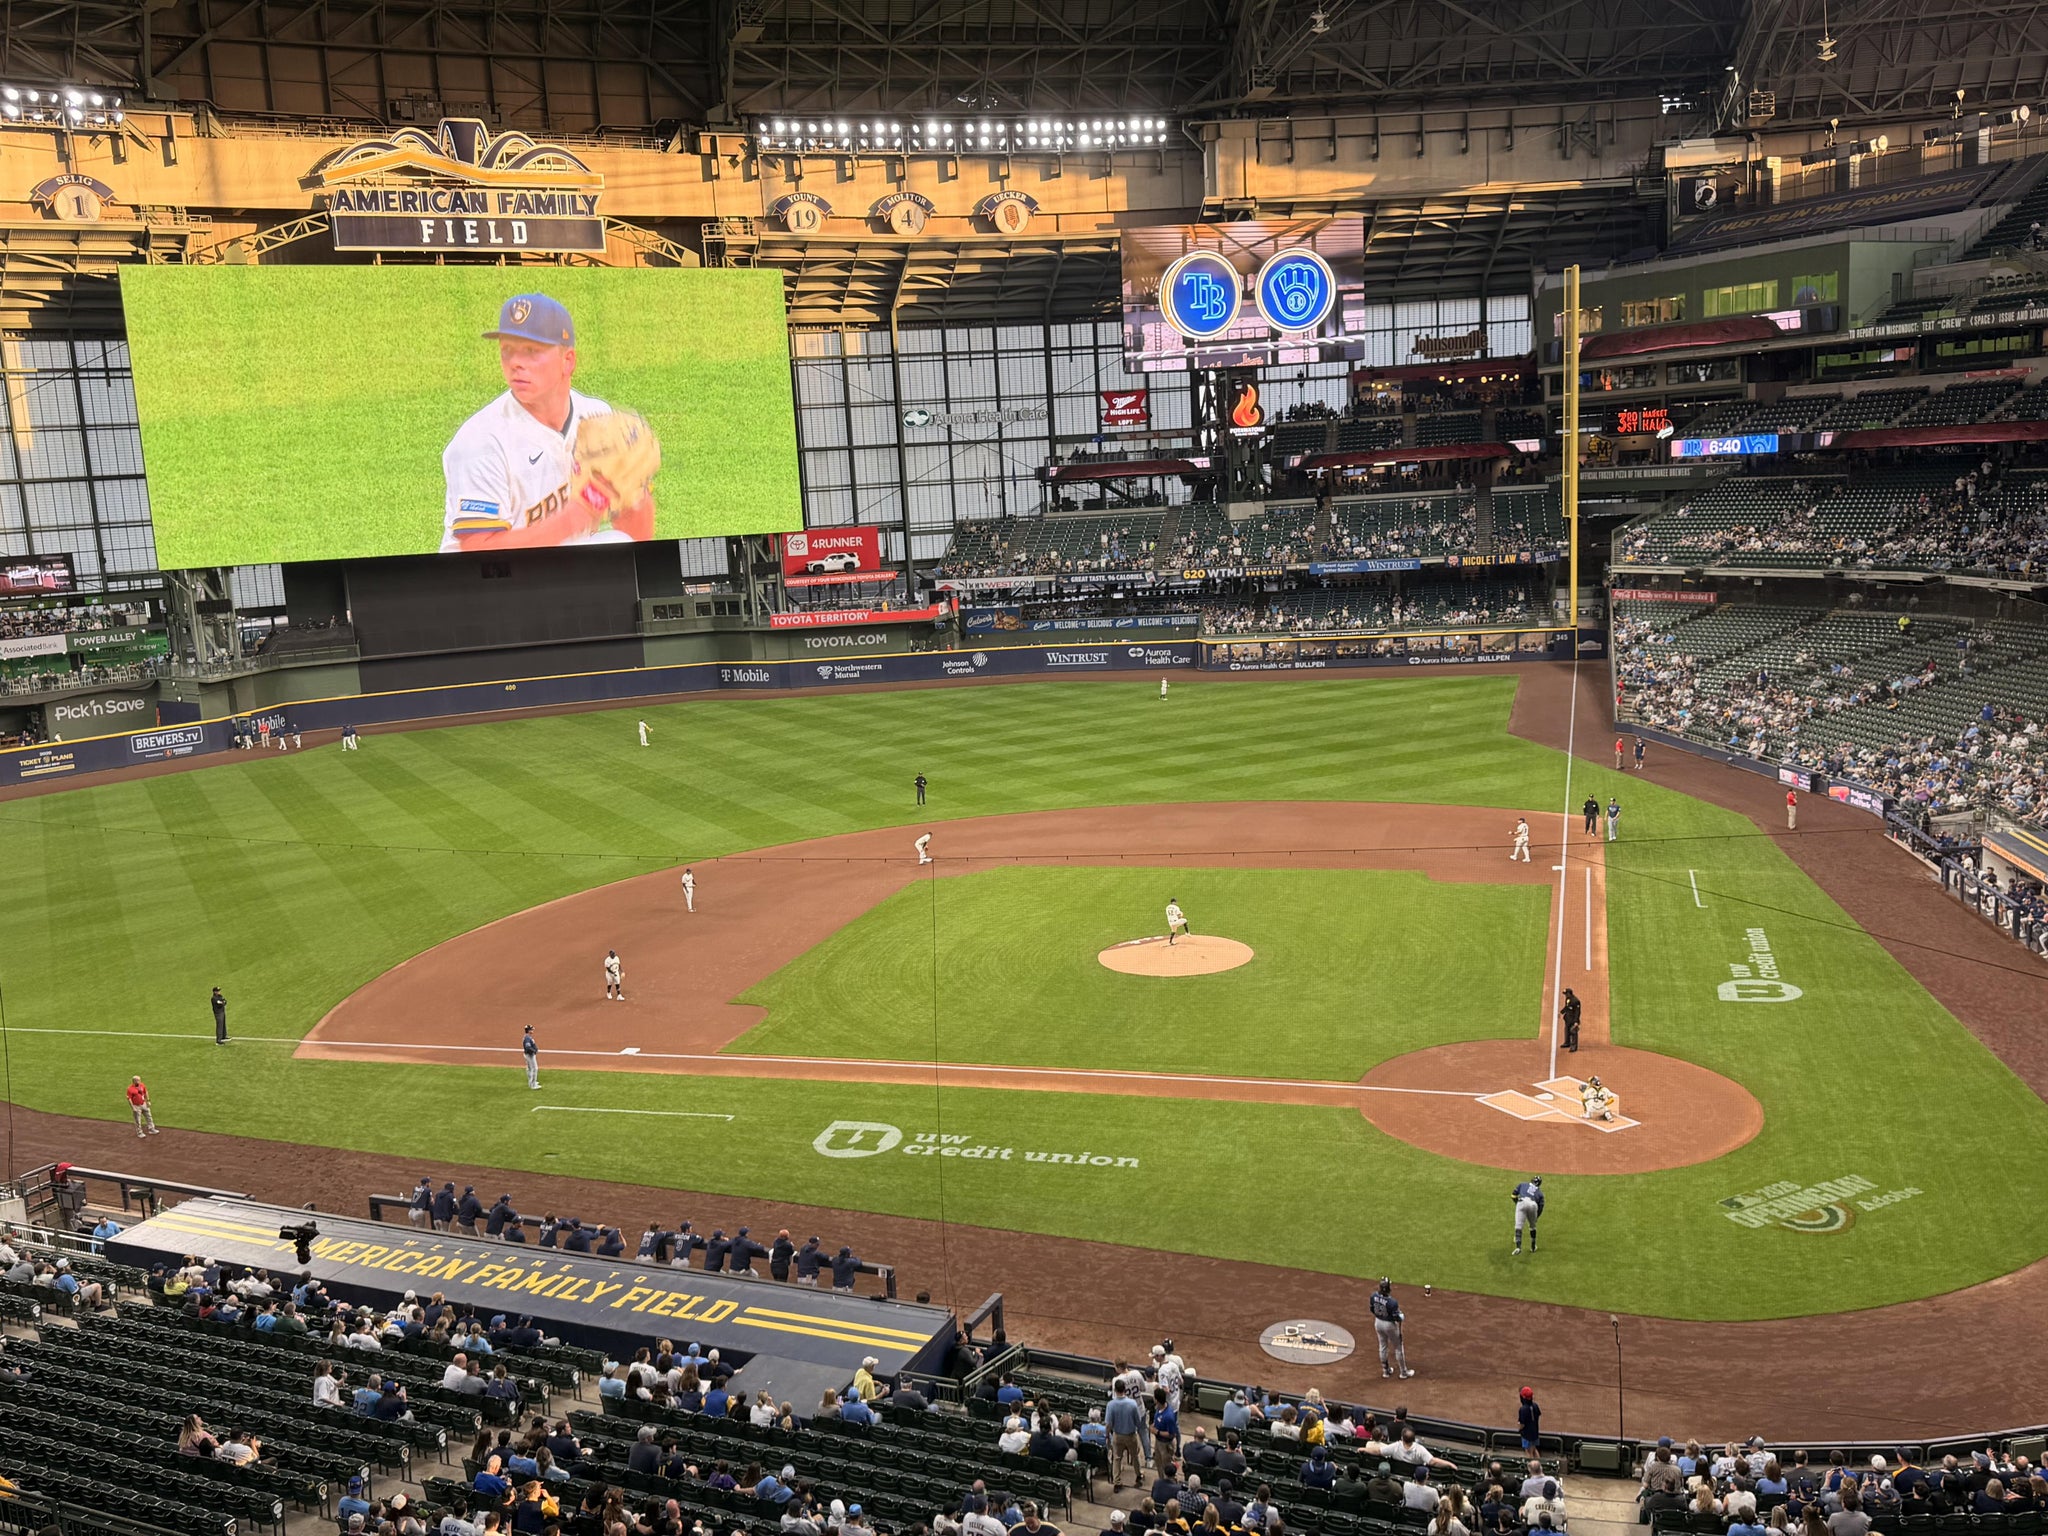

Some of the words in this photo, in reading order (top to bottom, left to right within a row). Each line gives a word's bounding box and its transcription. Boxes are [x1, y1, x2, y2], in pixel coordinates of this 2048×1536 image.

[56, 175, 93, 186] SELIG
[333, 189, 489, 214] AMERICAN
[501, 192, 600, 217] FAMILY
[787, 193, 819, 204] YOUNT
[886, 193, 928, 206] MOLITOR
[993, 191, 1027, 203] UECKER
[72, 195, 89, 218] 1
[1719, 217, 1765, 233] MUST
[1765, 212, 1787, 224] BE
[1790, 208, 1809, 219] IN
[1815, 202, 1849, 214] THE
[1850, 190, 1914, 208] FRONT
[1916, 180, 1973, 197] ROW!
[792, 210, 817, 230] 19
[900, 208, 912, 228] 4
[421, 219, 528, 245] FIELD
[1183, 273, 1227, 320] TB
[1849, 329, 1855, 339] TO
[1857, 327, 1874, 338] REPORT
[1876, 326, 1885, 337] FAN
[1886, 323, 1919, 335] MISCONDUCT:
[1922, 320, 1935, 331] TEXT
[1999, 312, 2016, 322] ISSUE
[2017, 310, 2028, 321] AND
[1411, 329, 1488, 354] Johnsonville
[935, 412, 975, 425] Aurora
[977, 407, 1018, 422] Health
[1019, 407, 1048, 421] Care
[1110, 408, 1126, 416] HIGH
[1127, 407, 1140, 415] LIFE
[1642, 408, 1667, 418] MARKET
[1642, 418, 1666, 431] HALL
[1709, 439, 1741, 454] 6:40
[1580, 471, 1598, 480] OFFICIAL
[1599, 470, 1614, 480] FROZEN
[1615, 469, 1627, 479] PIZZA
[1628, 469, 1634, 478] OF
[1634, 469, 1642, 478] THE
[1643, 468, 1669, 478] MILWAUKEE
[812, 536, 863, 549] 4RUNNER
[1367, 559, 1415, 570] WINTRUST
[1462, 556, 1496, 567] NICOLET
[1499, 554, 1516, 565] LAW
[786, 578, 808, 586] COURTESY
[830, 575, 857, 583] WISCONSIN
[857, 573, 874, 581] TOYOTA
[875, 572, 895, 580] DEALERS
[1116, 573, 1144, 581] CALORIES.
[1183, 569, 1205, 580] 620
[1207, 568, 1243, 578] WTMJ
[1246, 569, 1282, 577] BREWERS
[1637, 591, 1653, 599] family
[773, 614, 812, 625] TOYOTA
[814, 611, 869, 623] TERRITORY
[1054, 620, 1079, 630] WELCOME
[1088, 619, 1112, 628] DELICIOUS
[1138, 617, 1164, 627] WELCOME
[1171, 616, 1198, 626] DELICIOUS
[74, 635, 106, 647] POWER
[108, 632, 136, 643] ALLEY
[804, 633, 887, 649] TOYOTA.COM
[139, 643, 156, 651] CREW
[1146, 649, 1171, 657] Aurora
[942, 660, 969, 669] Johnson
[1047, 652, 1108, 664] WINTRUST
[1145, 656, 1171, 665] Health
[1172, 655, 1190, 664] Care
[834, 664, 882, 673] Northwestern
[947, 666, 975, 675] Controls
[1295, 661, 1325, 669] BULLPEN
[733, 668, 770, 682] Mobile
[834, 671, 860, 679] Mutual
[105, 698, 145, 714] Save
[136, 732, 198, 749] BREWERS.TV
[19, 757, 41, 767] TICKET
[51, 752, 73, 762] PLANS
[915, 1132, 971, 1144] uw
[902, 1143, 1013, 1162] credit
[1024, 1151, 1140, 1169] union
[1724, 1186, 1841, 1229] OPENING
[1813, 1173, 1879, 1199] DAY
[1856, 1186, 1925, 1212] Adobe
[541, 1230, 549, 1241] 7
[675, 1239, 683, 1252] 9
[403, 1239, 573, 1272] WELCOME
[608, 1271, 648, 1283] TO
[462, 1263, 624, 1304] FAMILY
[610, 1286, 739, 1325] FIELD
